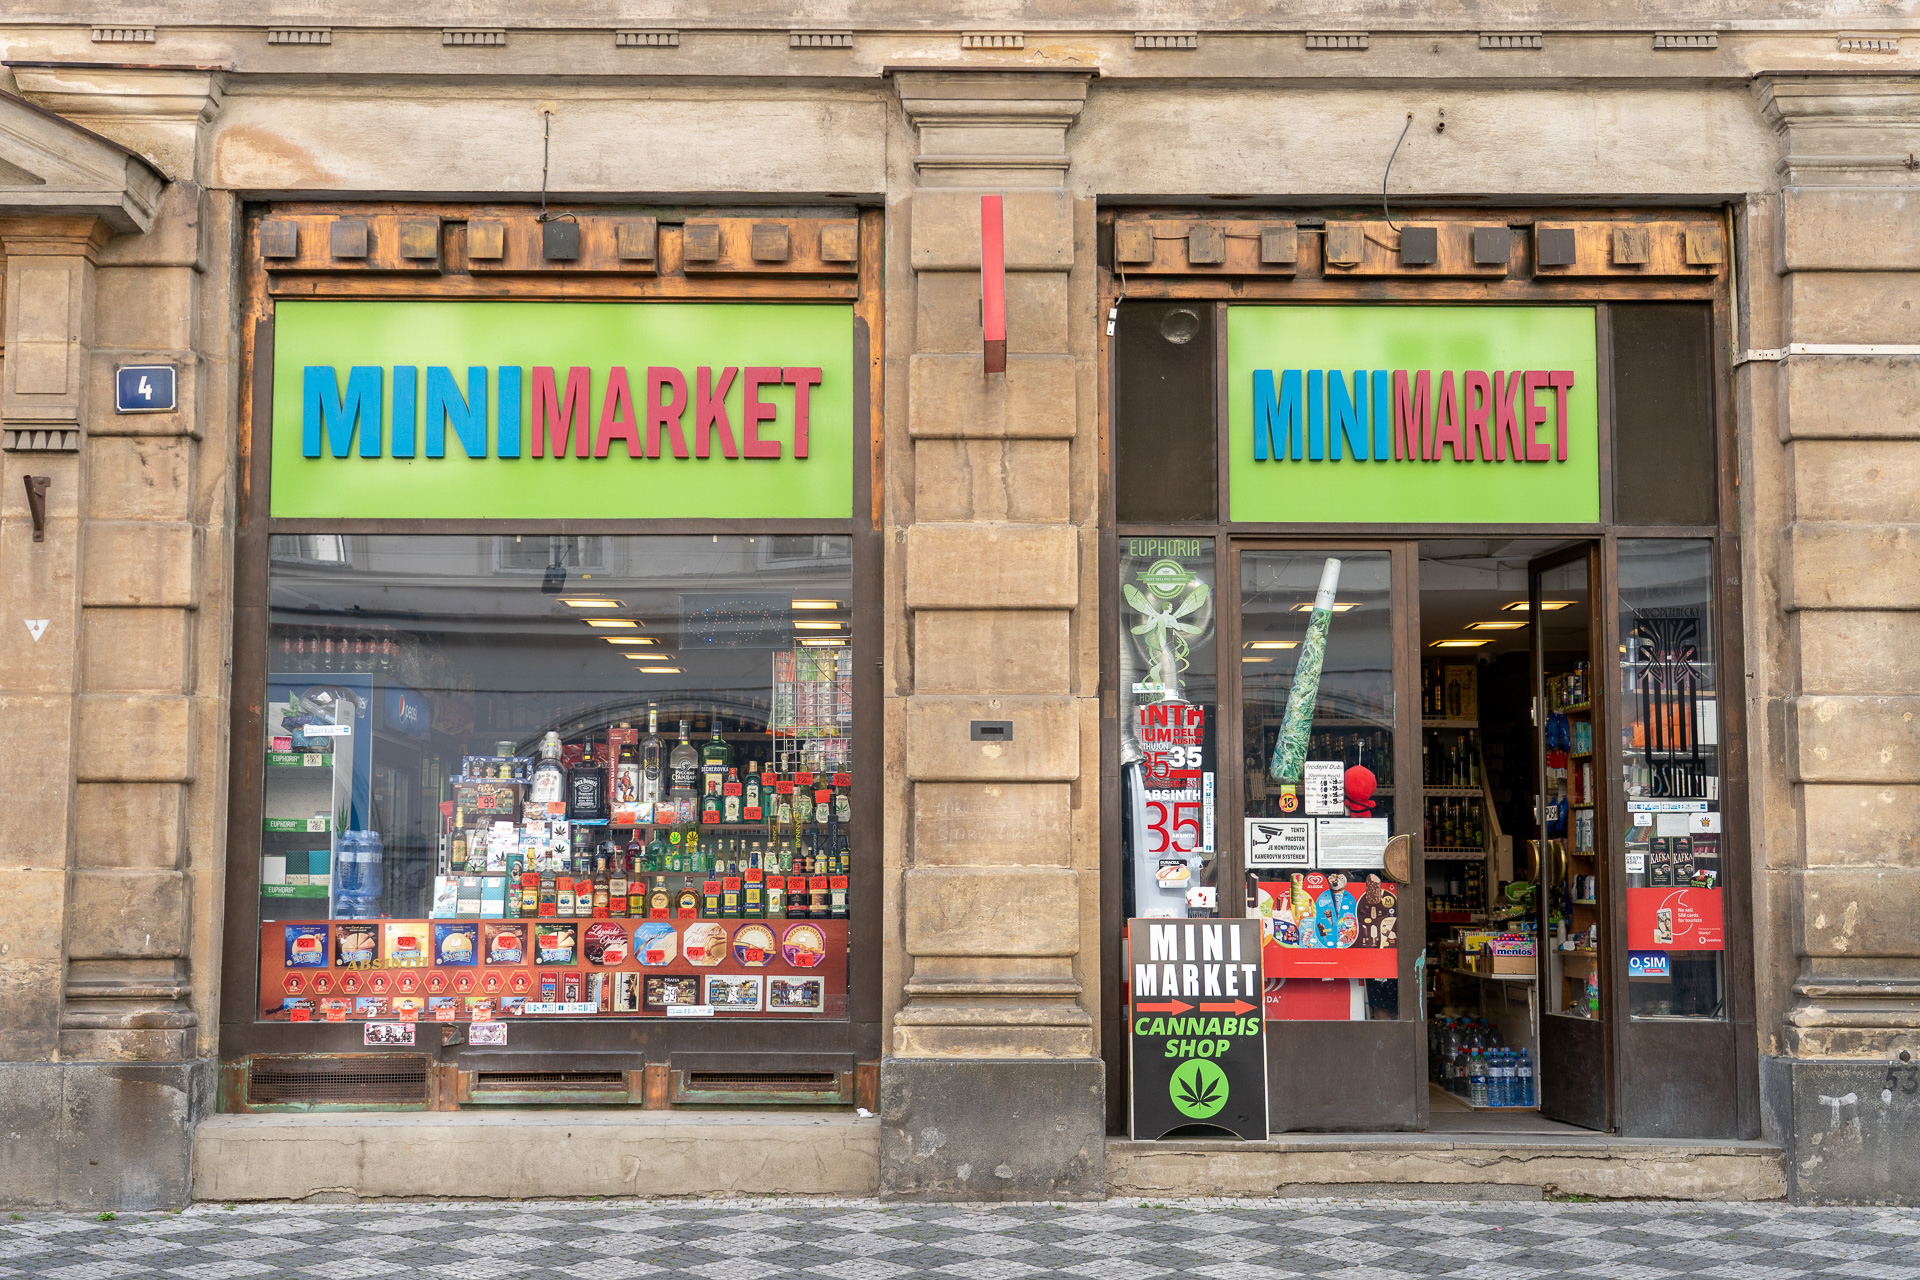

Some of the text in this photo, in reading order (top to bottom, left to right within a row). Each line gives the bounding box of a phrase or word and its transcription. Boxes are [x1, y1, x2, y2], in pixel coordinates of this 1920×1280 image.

[138, 375, 153, 401] 4
[1130, 539, 1200, 557] EUPHORIA
[688, 611, 784, 635] OPEN
[1142, 728, 1171, 742] UM
[1169, 746, 1203, 768] 35
[483, 797, 495, 808] 99
[1145, 789, 1201, 801] ABSINTH
[1146, 801, 1200, 852] 35
[1650, 852, 1670, 864] KAFKA
[1673, 852, 1693, 864] KAFKA
[1149, 924, 1241, 961] MINI
[346, 956, 429, 971] ABSINTH
[1643, 957, 1666, 968] SIM
[1135, 964, 1257, 997] MARKET
[1134, 1017, 1260, 1036] CANNABIS
[1164, 1039, 1231, 1058] SHOP
